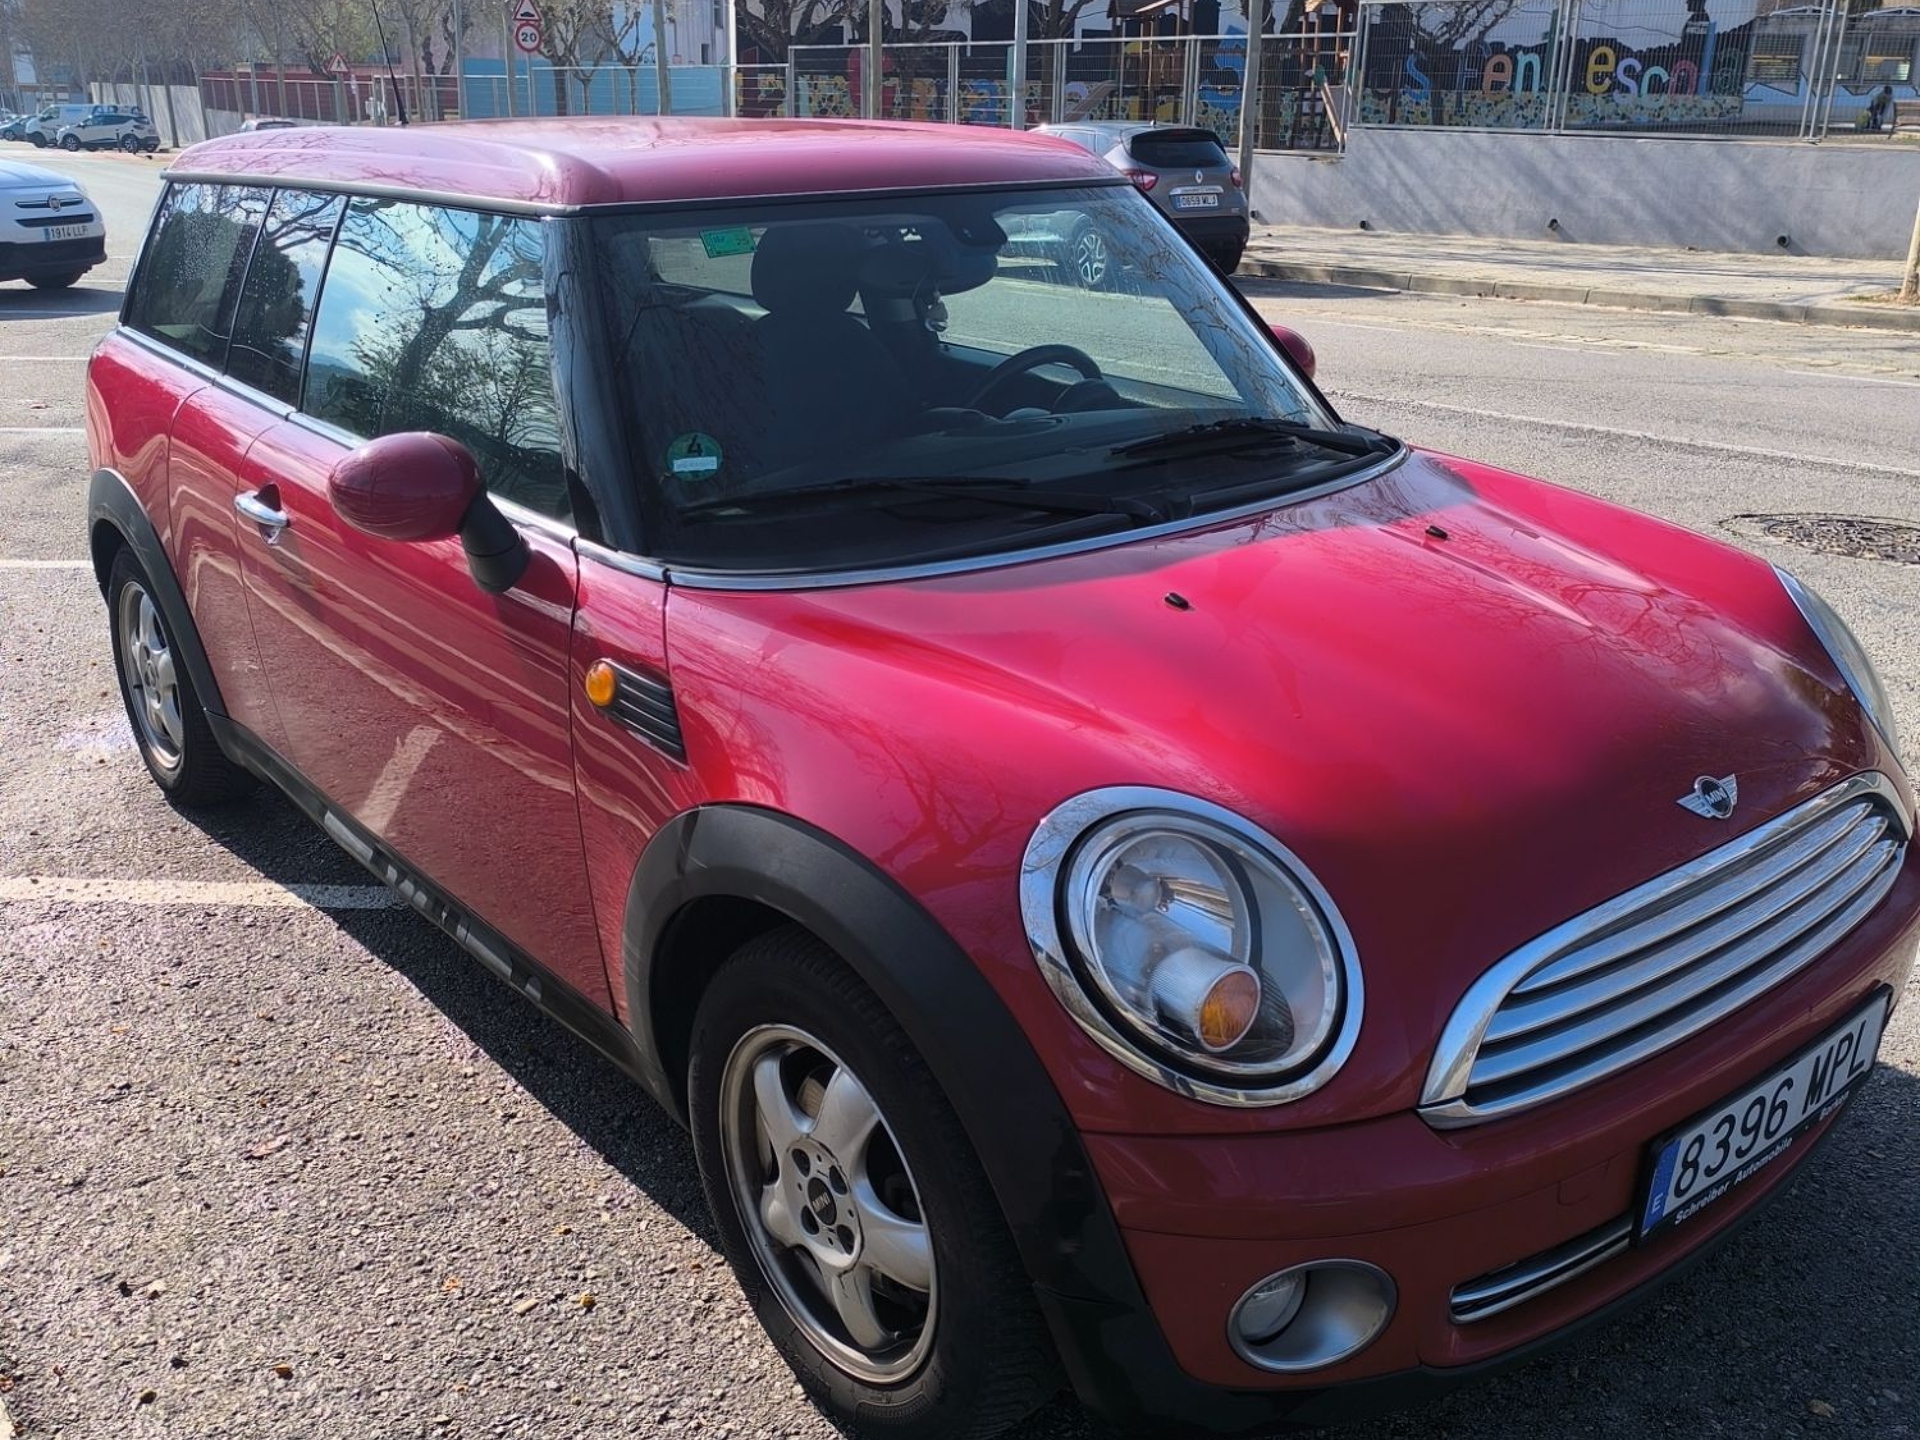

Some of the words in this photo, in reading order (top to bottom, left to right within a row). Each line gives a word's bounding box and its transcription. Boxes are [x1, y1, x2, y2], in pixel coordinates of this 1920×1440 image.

[521, 32, 537, 43] 20
[1704, 786, 1728, 806] MINI
[1673, 1076, 1794, 1199] 8396
[1801, 1019, 1868, 1115] MPL
[812, 1191, 831, 1213] MINI
[1650, 1193, 1662, 1213] E
[1674, 1180, 1730, 1225] Schreiber
